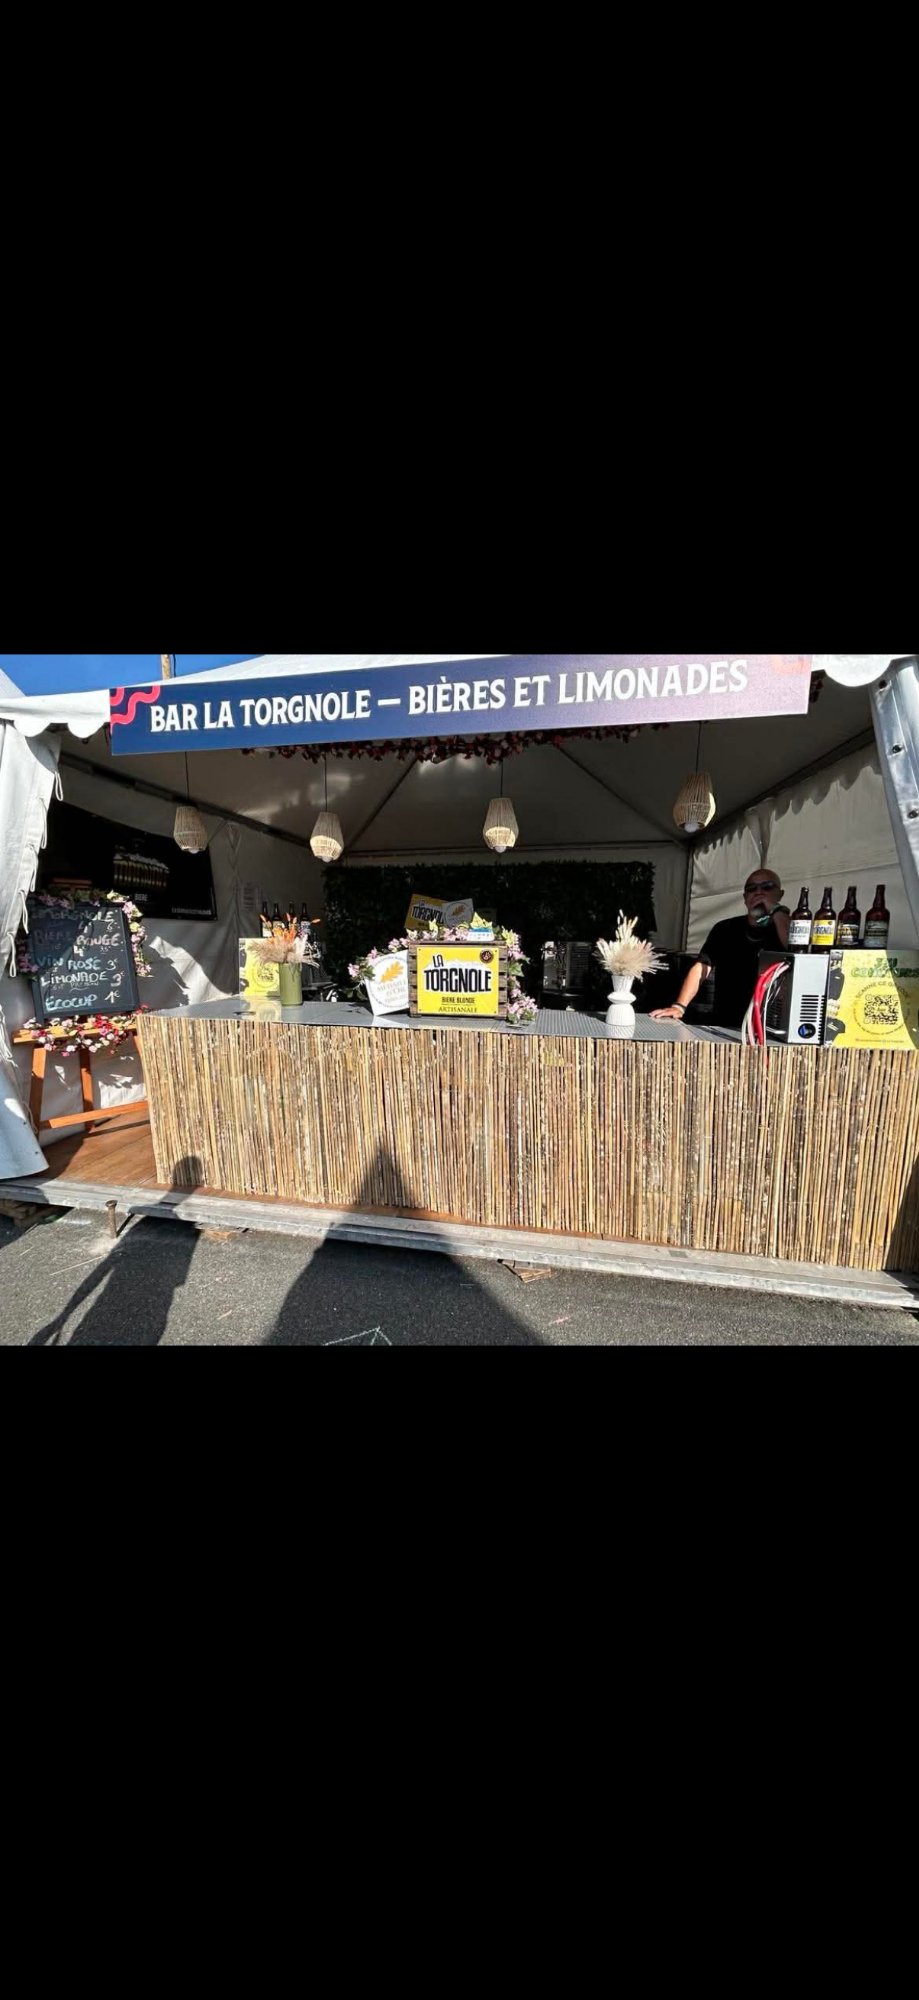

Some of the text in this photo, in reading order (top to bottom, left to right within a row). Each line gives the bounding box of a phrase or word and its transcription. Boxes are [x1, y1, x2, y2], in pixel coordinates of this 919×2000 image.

[150, 702, 199, 732] BAR
[203, 700, 235, 730] LA
[239, 689, 371, 727] TORGNOLE
[408, 675, 506, 715] BIÈRES
[512, 675, 552, 708] ET
[557, 659, 749, 704] LIMONADES
[412, 906, 446, 924] TORGNOL
[433, 954, 444, 968] LA
[424, 967, 492, 993] TORGNOLE
